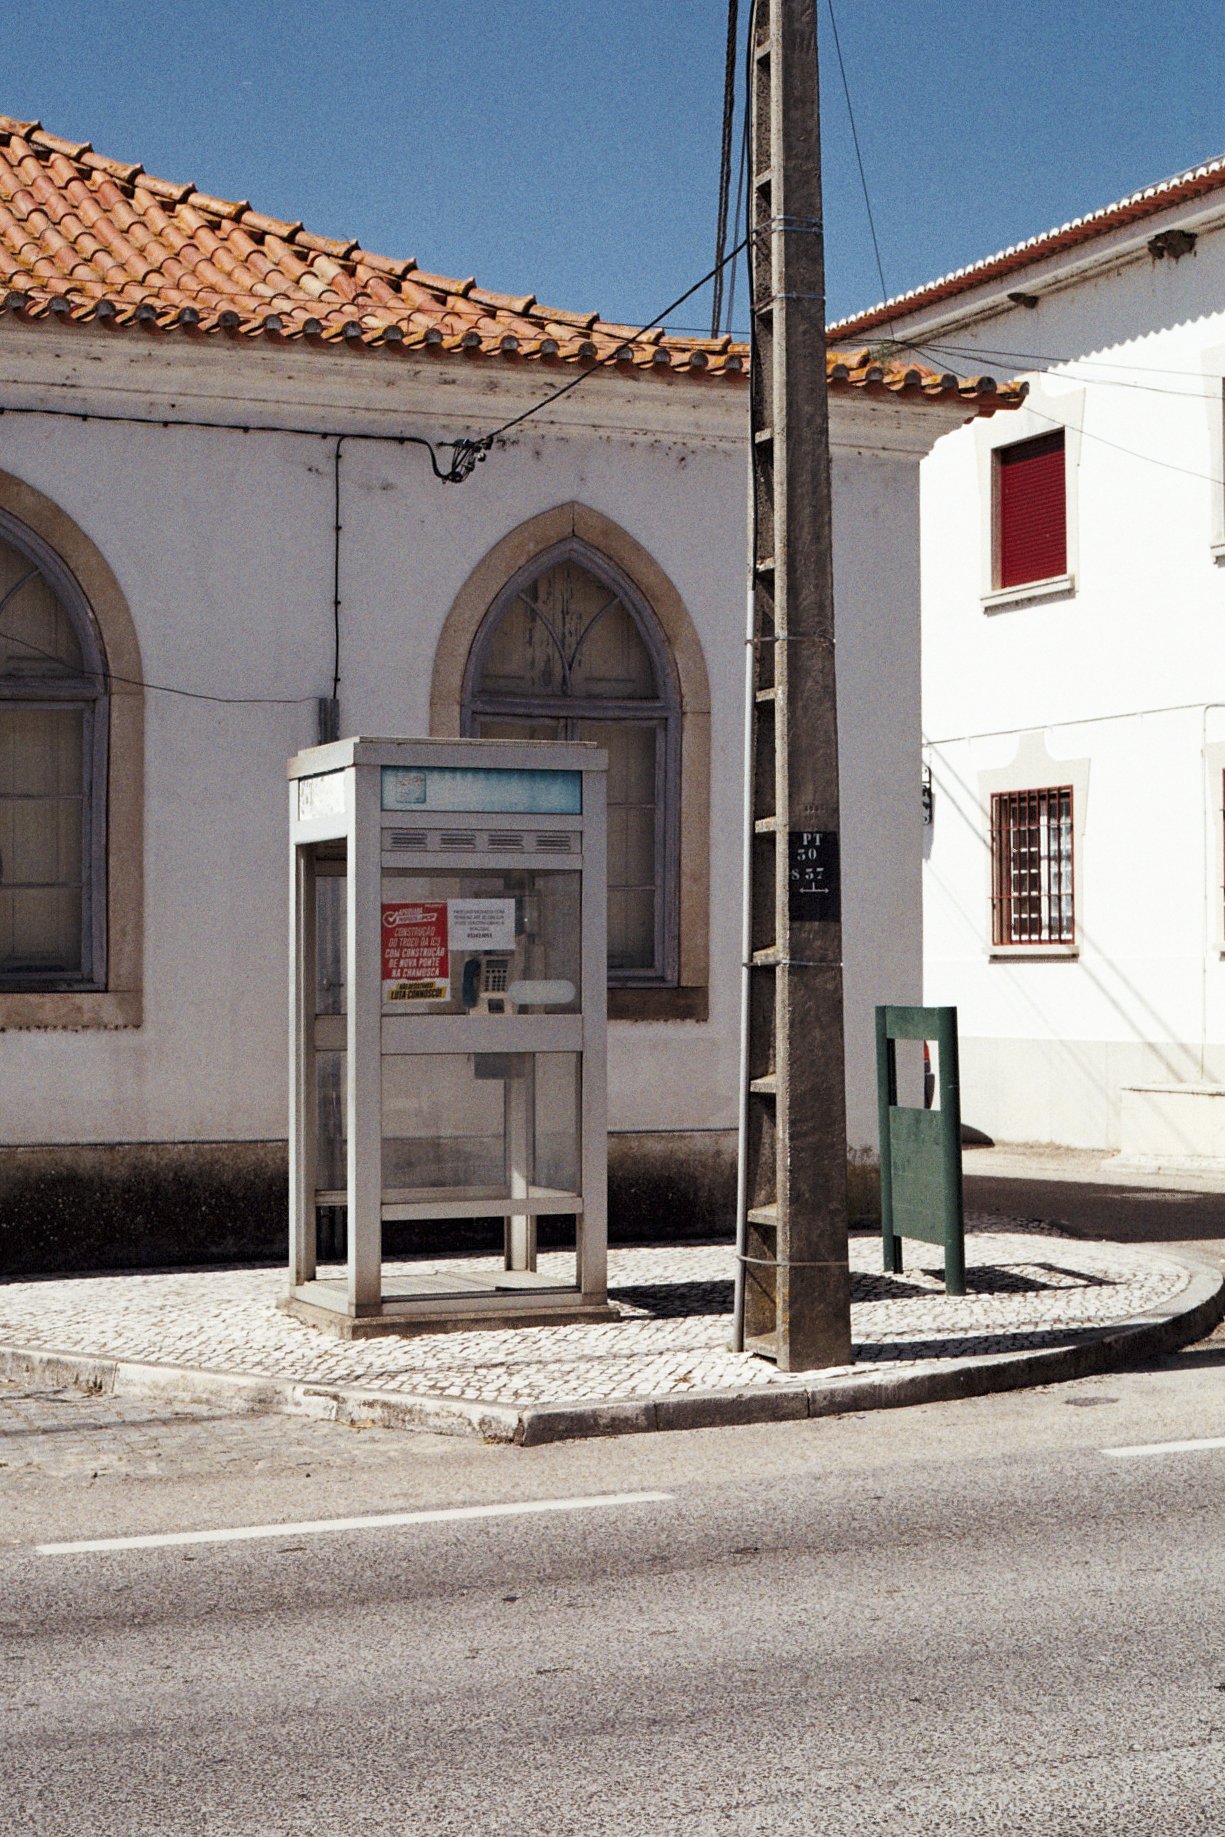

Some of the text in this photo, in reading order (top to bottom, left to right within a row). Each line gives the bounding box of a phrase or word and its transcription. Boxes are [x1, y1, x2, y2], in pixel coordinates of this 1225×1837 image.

[803, 833, 823, 845] PT
[395, 926, 436, 937] CONSTRUÇÃO
[389, 937, 398, 947] DO
[385, 946, 445, 958] COM CONSTRUÇÃO
[389, 958, 440, 968] DE NOVA PONTE
[392, 967, 440, 977] NA CHAMUSCA
[391, 990, 405, 1000] LUTA
